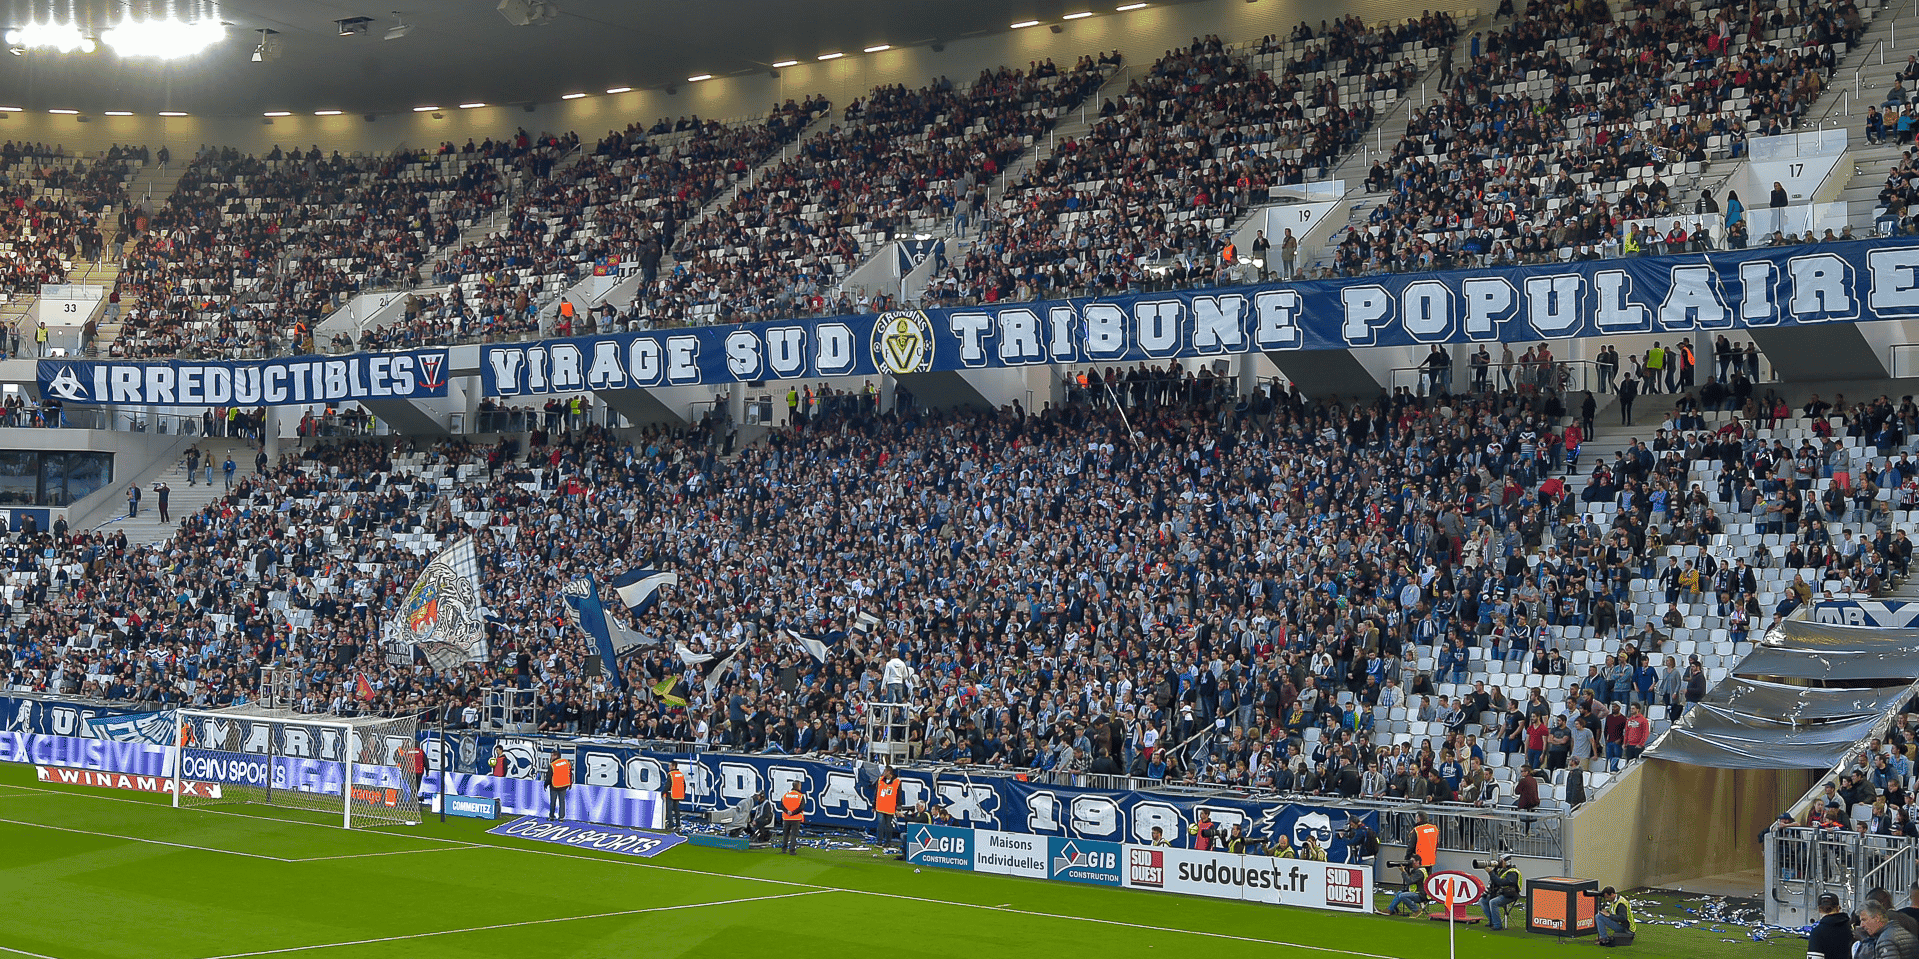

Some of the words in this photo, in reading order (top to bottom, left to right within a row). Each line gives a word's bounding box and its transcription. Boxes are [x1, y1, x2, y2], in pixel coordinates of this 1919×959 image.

[1789, 163, 1804, 178] 17
[1298, 210, 1311, 222] 19
[64, 303, 77, 313] 33
[489, 335, 700, 395] VIRAGE
[725, 322, 856, 382] SUD
[950, 290, 1303, 367] TRIBUNE
[1341, 246, 1919, 347] POPULAIRE
[93, 355, 415, 404] IRREDUCTIBLES
[229, 761, 286, 785] SPORS
[58, 769, 198, 795] WINAMAX
[452, 801, 490, 813] COMMENTEZ
[567, 829, 661, 853] SPORTS
[939, 836, 965, 853] GIB
[990, 835, 1032, 850] Maisons
[922, 854, 968, 866] CONSTRUCTION
[977, 852, 1044, 870] Individuelles
[1088, 851, 1116, 869] GIB
[1131, 849, 1152, 866] SUD
[1068, 870, 1119, 882] CONSTRUCTION
[1131, 867, 1163, 883] OUEST
[1178, 859, 1308, 892] sudouest.fr
[1326, 868, 1350, 886] SUD
[1326, 885, 1362, 904] OUEST
